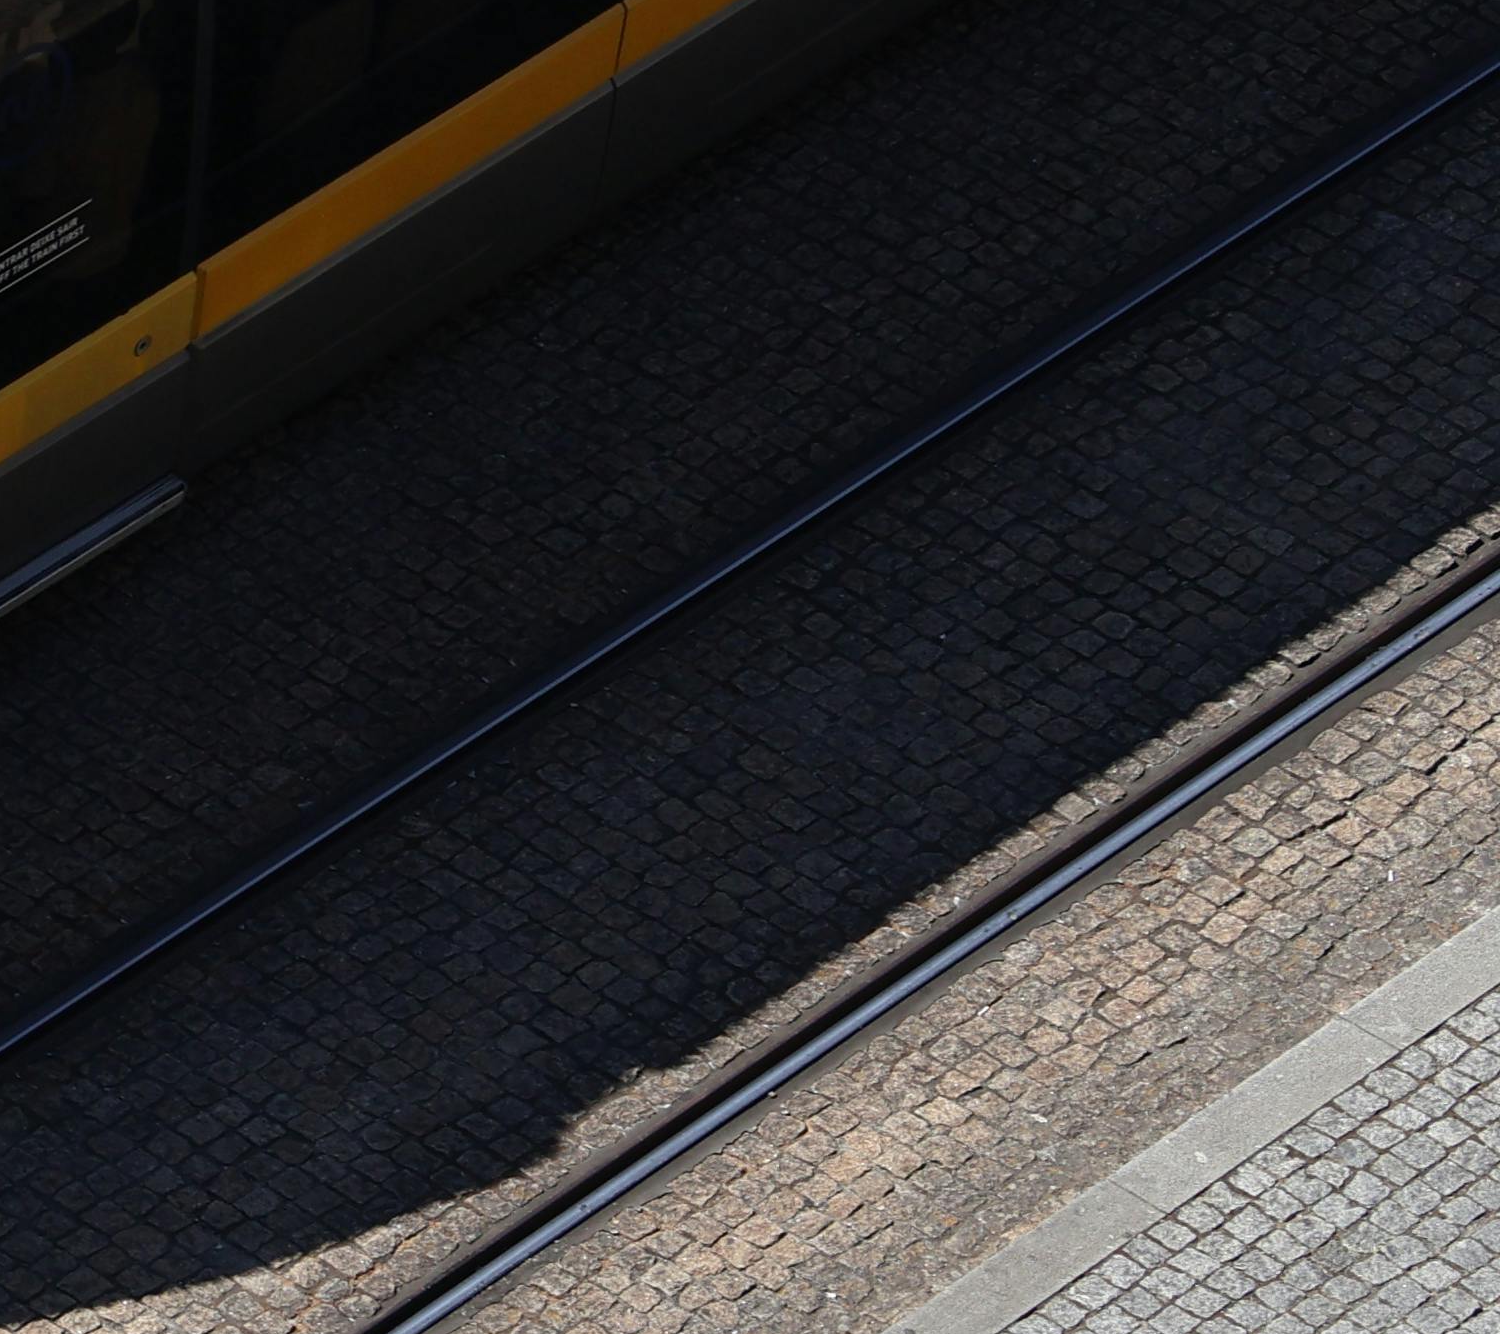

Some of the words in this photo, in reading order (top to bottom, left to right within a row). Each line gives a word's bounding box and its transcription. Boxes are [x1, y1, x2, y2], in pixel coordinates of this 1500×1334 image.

[12, 257, 31, 275] THE
[31, 241, 58, 264] TRAIN
[58, 224, 86, 247] FIRST
[30, 230, 56, 253] DEIXE
[56, 217, 79, 237] SAIR
